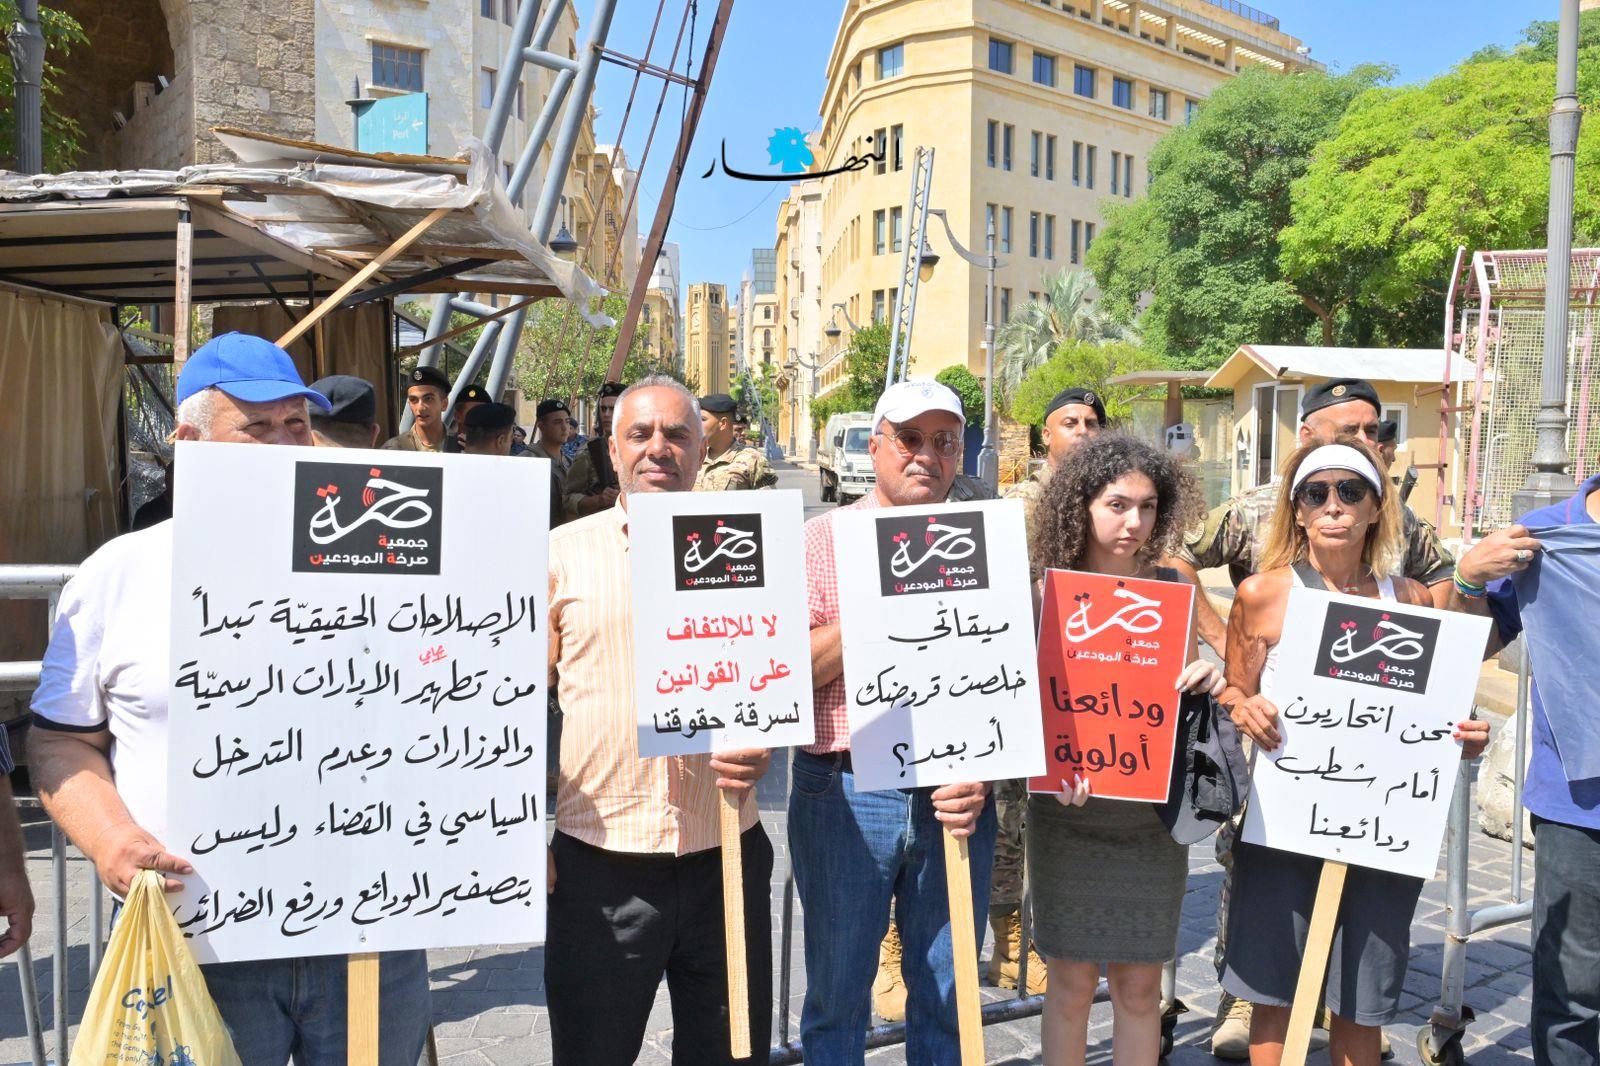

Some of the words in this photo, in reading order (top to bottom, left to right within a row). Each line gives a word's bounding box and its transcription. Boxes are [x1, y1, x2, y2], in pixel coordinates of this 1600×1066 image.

[309, 552, 384, 566] المودعين
[378, 534, 429, 550] جمعية
[386, 552, 429, 567] صرخة
[685, 574, 730, 586] المودعين
[725, 562, 757, 573] جمعية
[731, 573, 757, 584] صرخة
[938, 564, 975, 576] جمعية
[946, 577, 978, 588] صرخة
[894, 579, 944, 593] المودعين
[191, 585, 264, 640] تبدأ
[388, 592, 536, 649] الإصلاحات
[762, 614, 777, 638] لا
[887, 606, 1010, 652] ميقاتي
[1067, 649, 1122, 663] المودعين
[1123, 651, 1158, 666] صرخة
[1125, 636, 1160, 649] جمعية
[401, 659, 489, 714] تطهير
[656, 660, 740, 694] القوانين
[749, 658, 791, 692] على
[948, 664, 1027, 700] خلصت
[1329, 666, 1380, 683] المودعين
[1378, 661, 1416, 677] جمعية
[1381, 674, 1415, 689] صرخة
[493, 676, 536, 707] من
[855, 665, 941, 709] قروضك
[1050, 676, 1165, 728] ودائعنا
[652, 705, 726, 739] حقوقنا
[734, 702, 800, 733] لسرقة
[1283, 696, 1395, 734] انتحاريون
[404, 724, 533, 770] والوزارات
[974, 716, 1004, 758] أو
[1399, 721, 1454, 745] نحن
[192, 728, 303, 779] التدخل
[317, 747, 393, 785] وعدم
[1053, 733, 1151, 776] أولوية
[1274, 746, 1377, 788] شطب
[1384, 767, 1440, 806] أمام
[190, 805, 297, 855] وليس
[314, 800, 392, 838] القضاء
[404, 800, 433, 846] في
[439, 793, 538, 846] السياسي
[1308, 802, 1410, 852] ودائعنا
[280, 880, 344, 937] ورفع
[351, 870, 430, 925] الودائع
